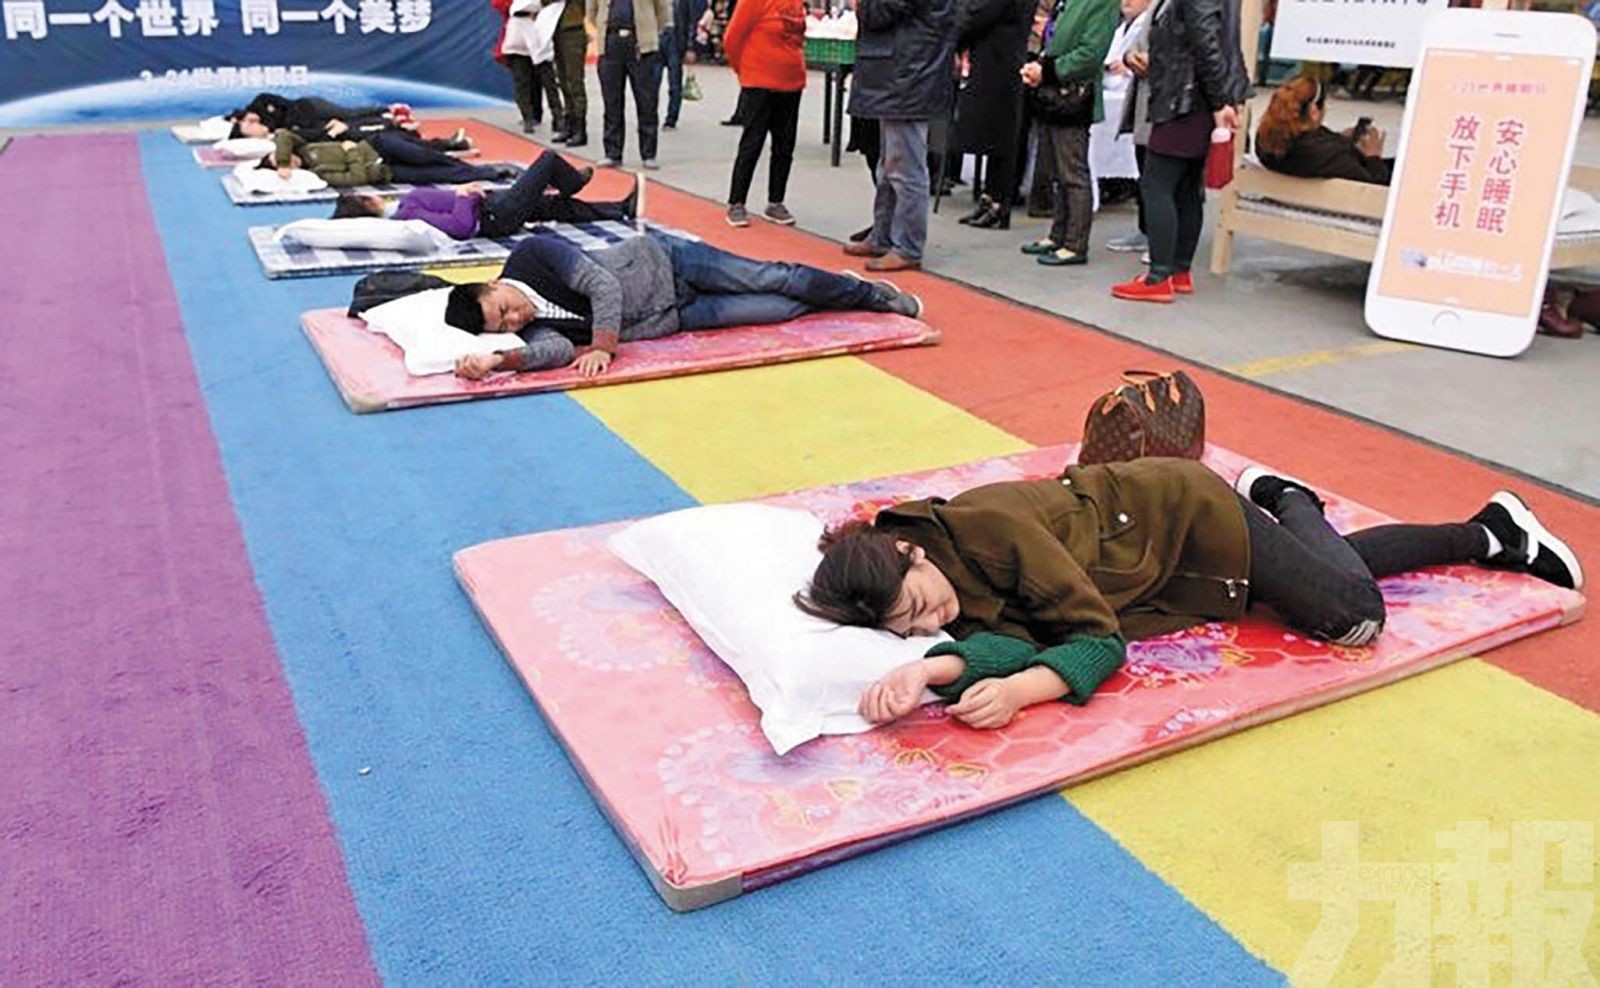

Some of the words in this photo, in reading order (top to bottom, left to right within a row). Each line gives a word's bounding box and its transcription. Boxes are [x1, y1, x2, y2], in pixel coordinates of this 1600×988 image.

[3, 0, 219, 39] 同一个世界
[241, 0, 432, 35] 同一个美梦
[1435, 115, 1480, 228] 放下手机
[1476, 119, 1524, 233] 安心睡眠
